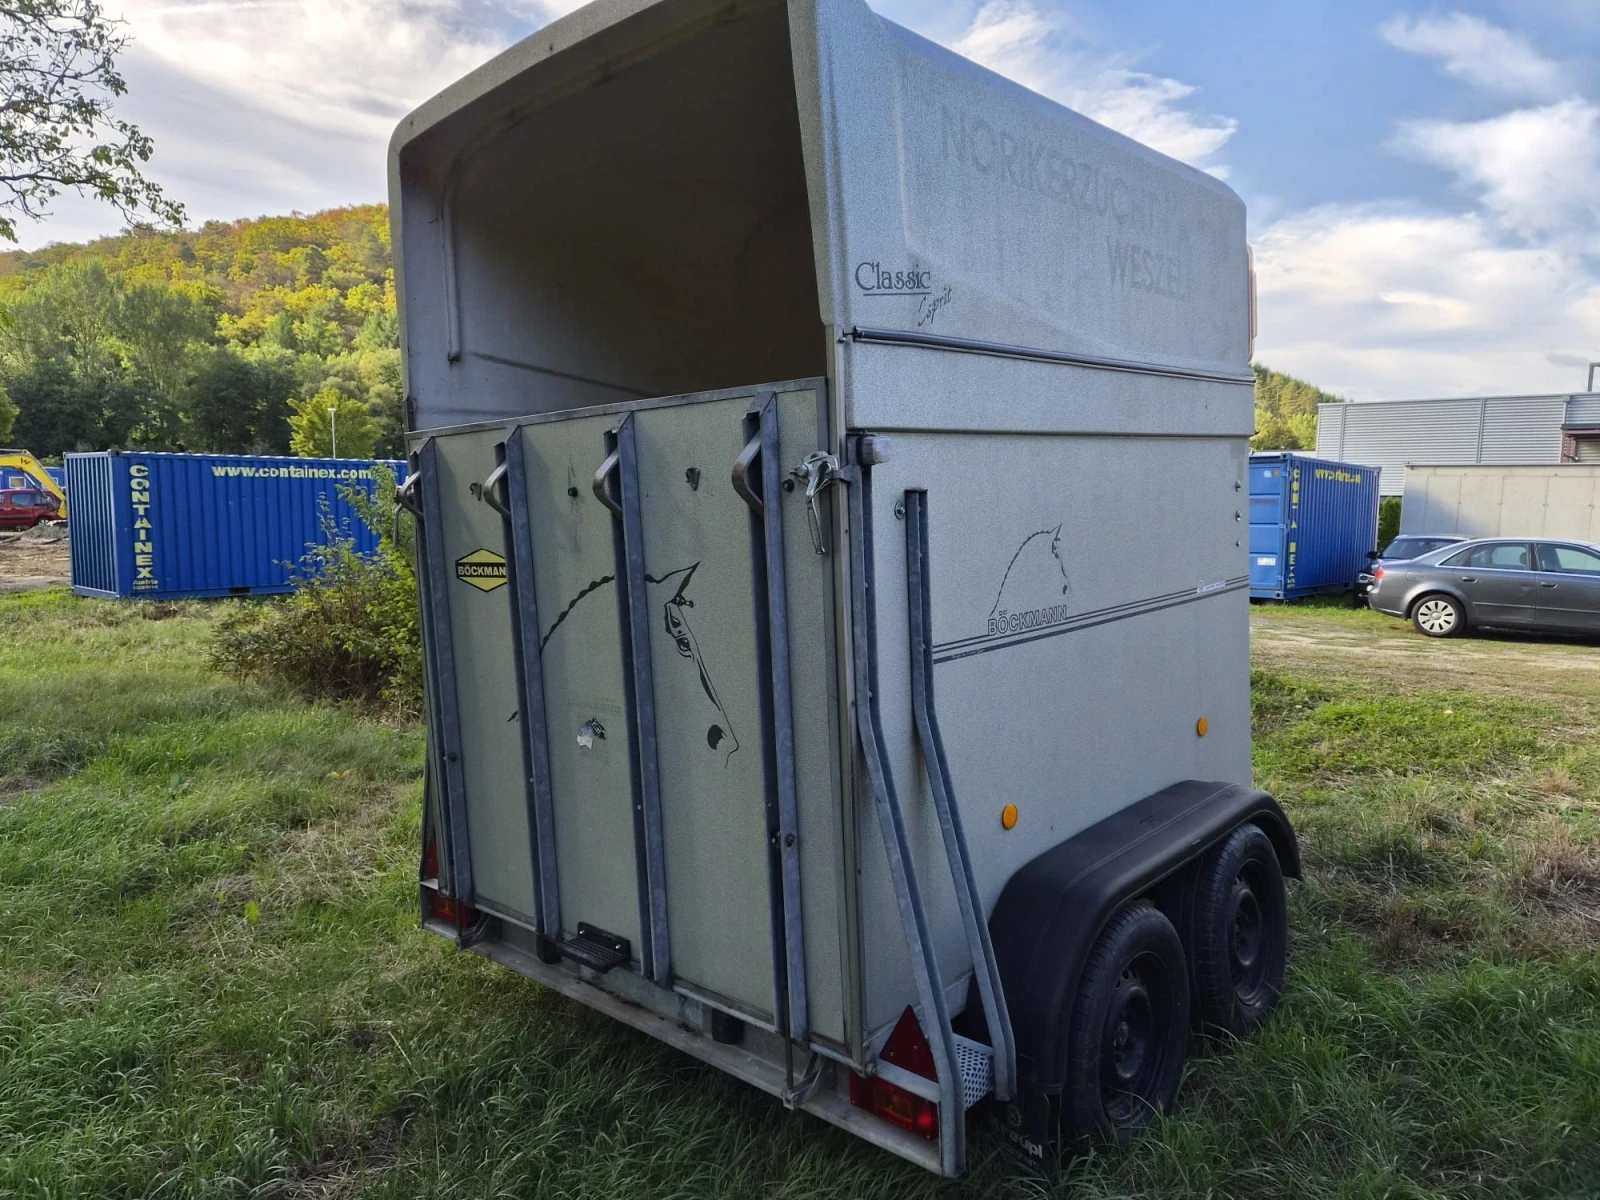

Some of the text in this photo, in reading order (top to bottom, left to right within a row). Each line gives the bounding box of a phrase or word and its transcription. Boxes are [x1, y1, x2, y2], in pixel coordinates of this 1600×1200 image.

[855, 261, 931, 291] Classic
[211, 464, 372, 479] www.containex.com
[129, 465, 154, 578] CONTAINEX
[988, 604, 1067, 636] BÖCKMANN
